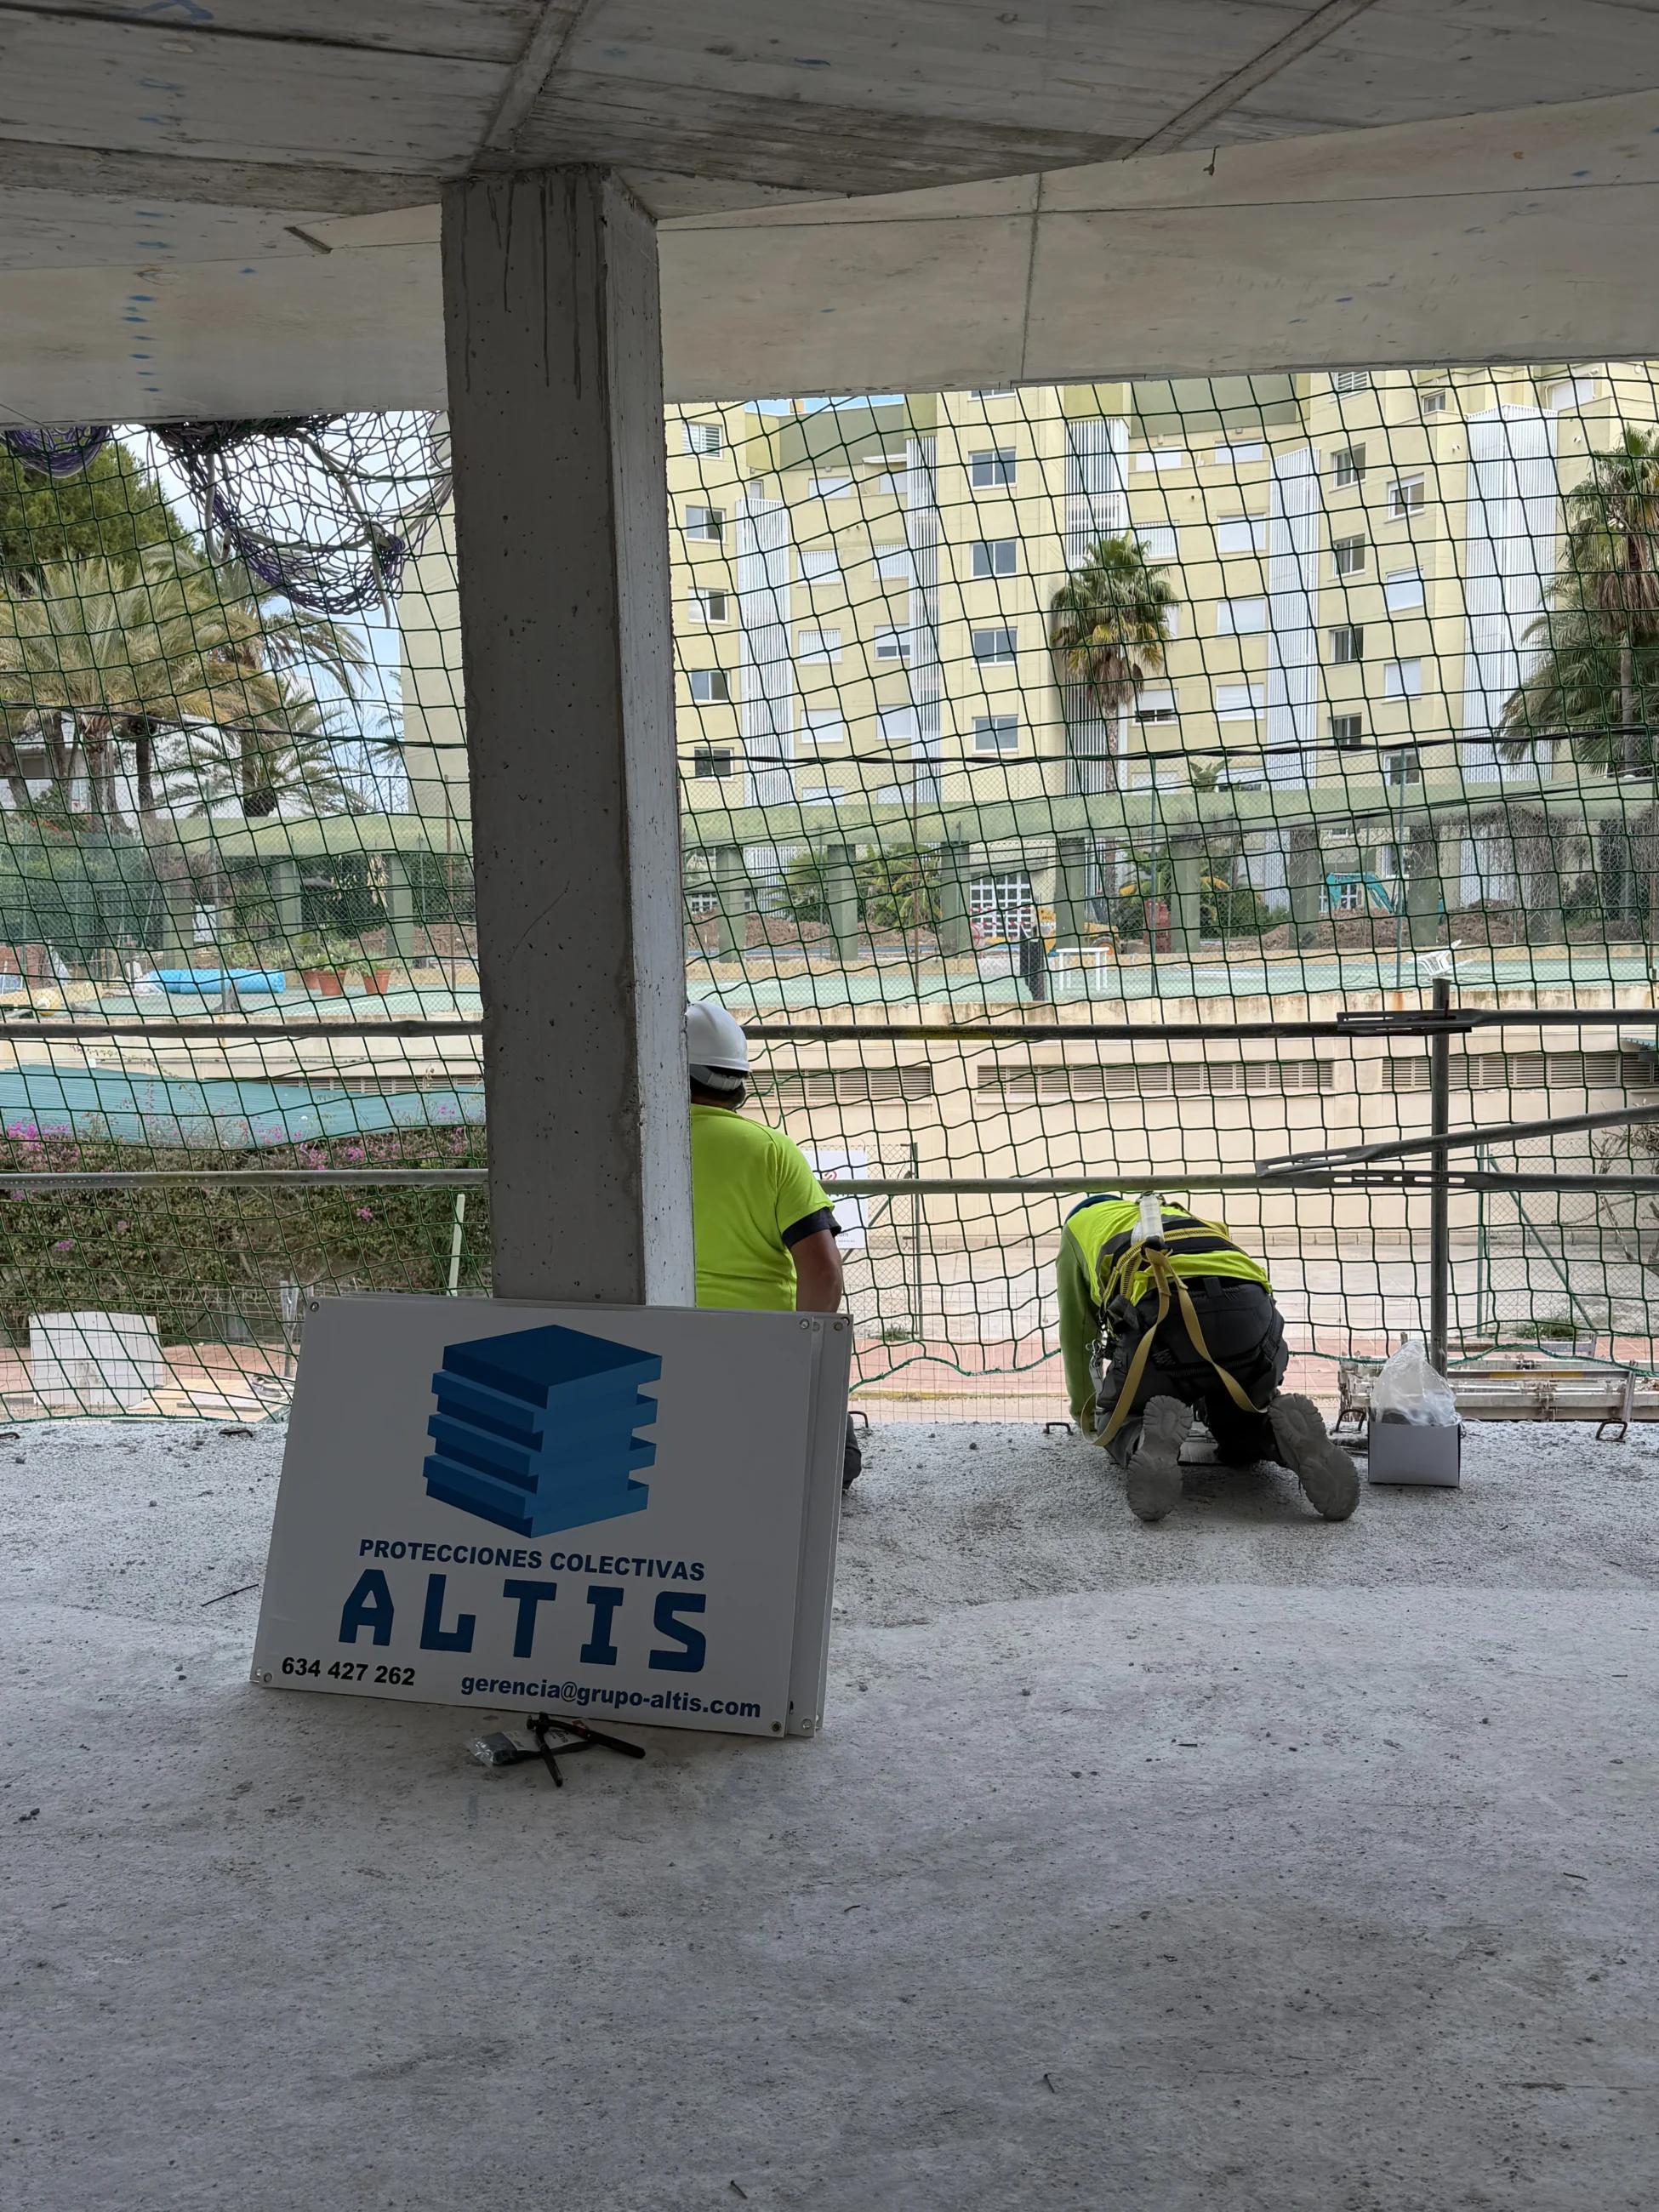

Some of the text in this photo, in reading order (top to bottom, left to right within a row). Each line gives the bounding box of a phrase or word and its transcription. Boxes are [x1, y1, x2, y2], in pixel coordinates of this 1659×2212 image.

[359, 1538, 705, 1582] PROTECCIONES COLECTIVAS
[338, 1568, 707, 1673] ALTIS
[282, 1656, 416, 1686] 634 427 262
[460, 1676, 761, 1719] gerencia@grupo-altis.com
